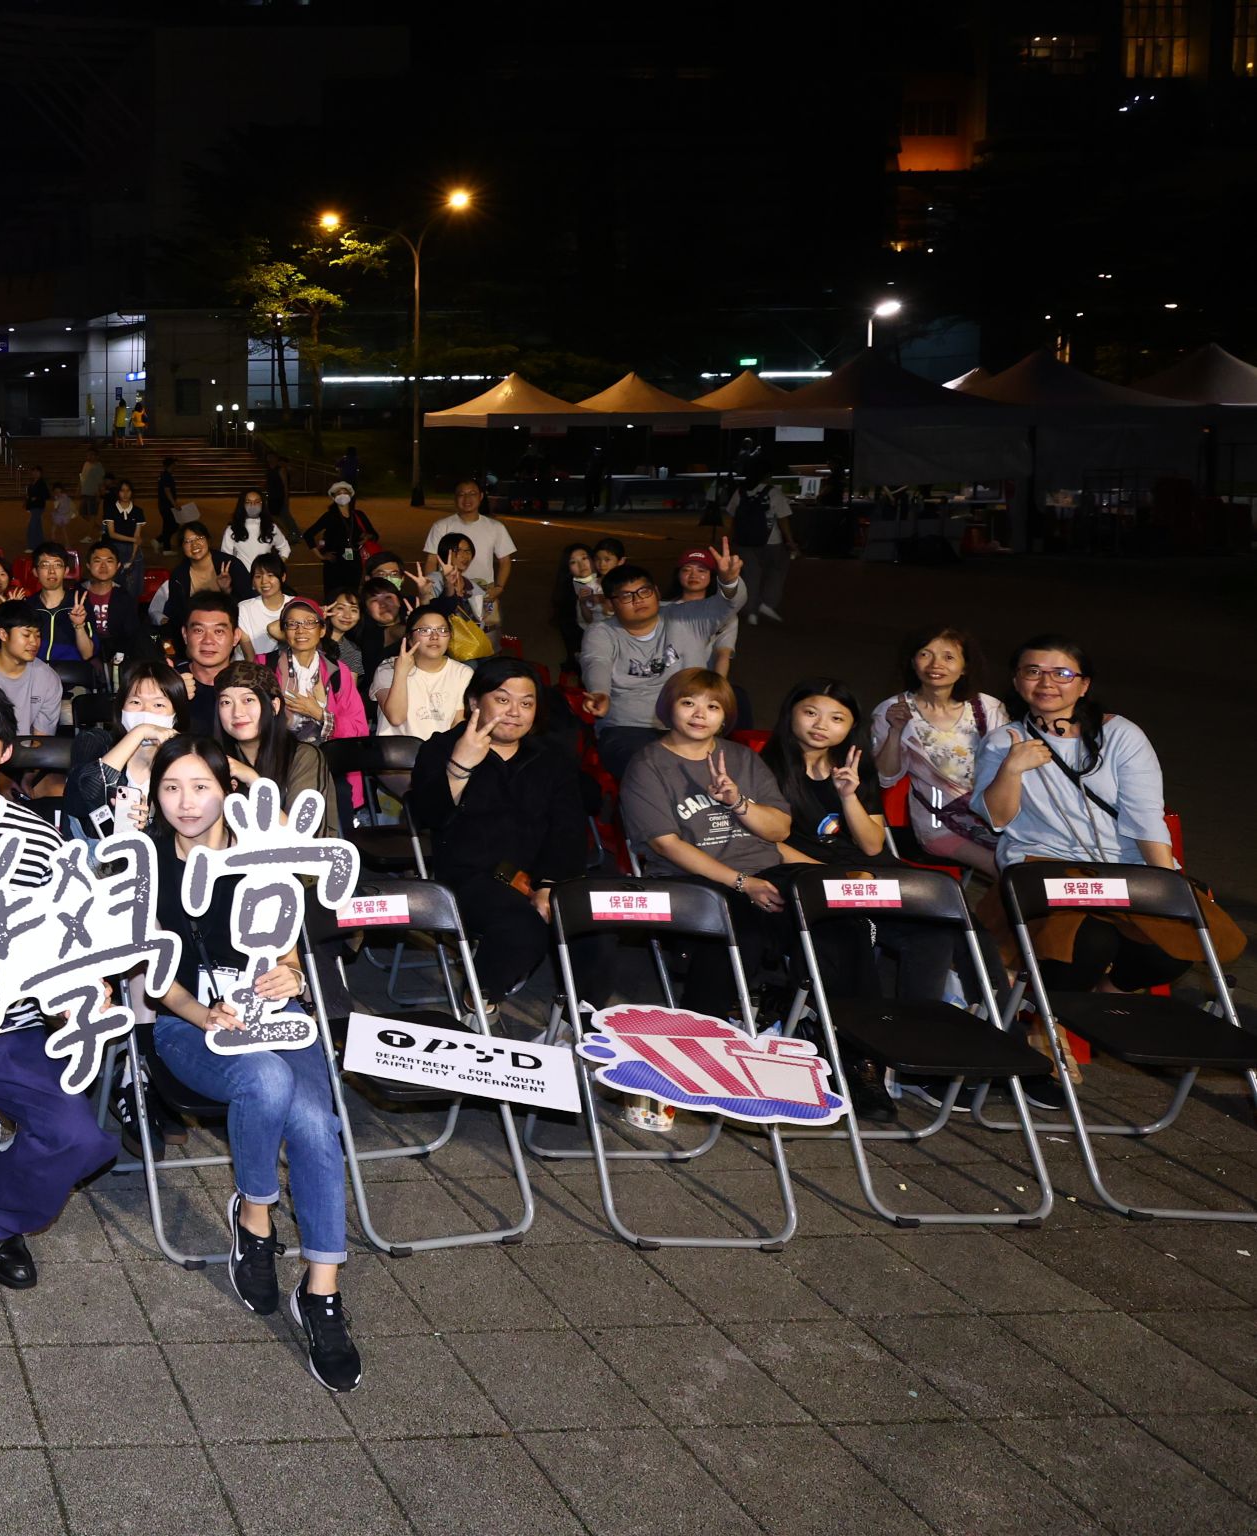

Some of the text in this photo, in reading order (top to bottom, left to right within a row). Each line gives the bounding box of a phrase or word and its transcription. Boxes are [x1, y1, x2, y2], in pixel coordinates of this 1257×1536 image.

[841, 883, 878, 897] 保留席
[1064, 882, 1104, 895] 保留席
[352, 900, 389, 914] 保留席
[609, 895, 648, 909] 保留席
[188, 784, 353, 1048] 堂
[375, 1051, 546, 1086] DEPARTMENT FOR YOUTH
[375, 1058, 546, 1094] TAIPEI CITY GOVERNMENT
